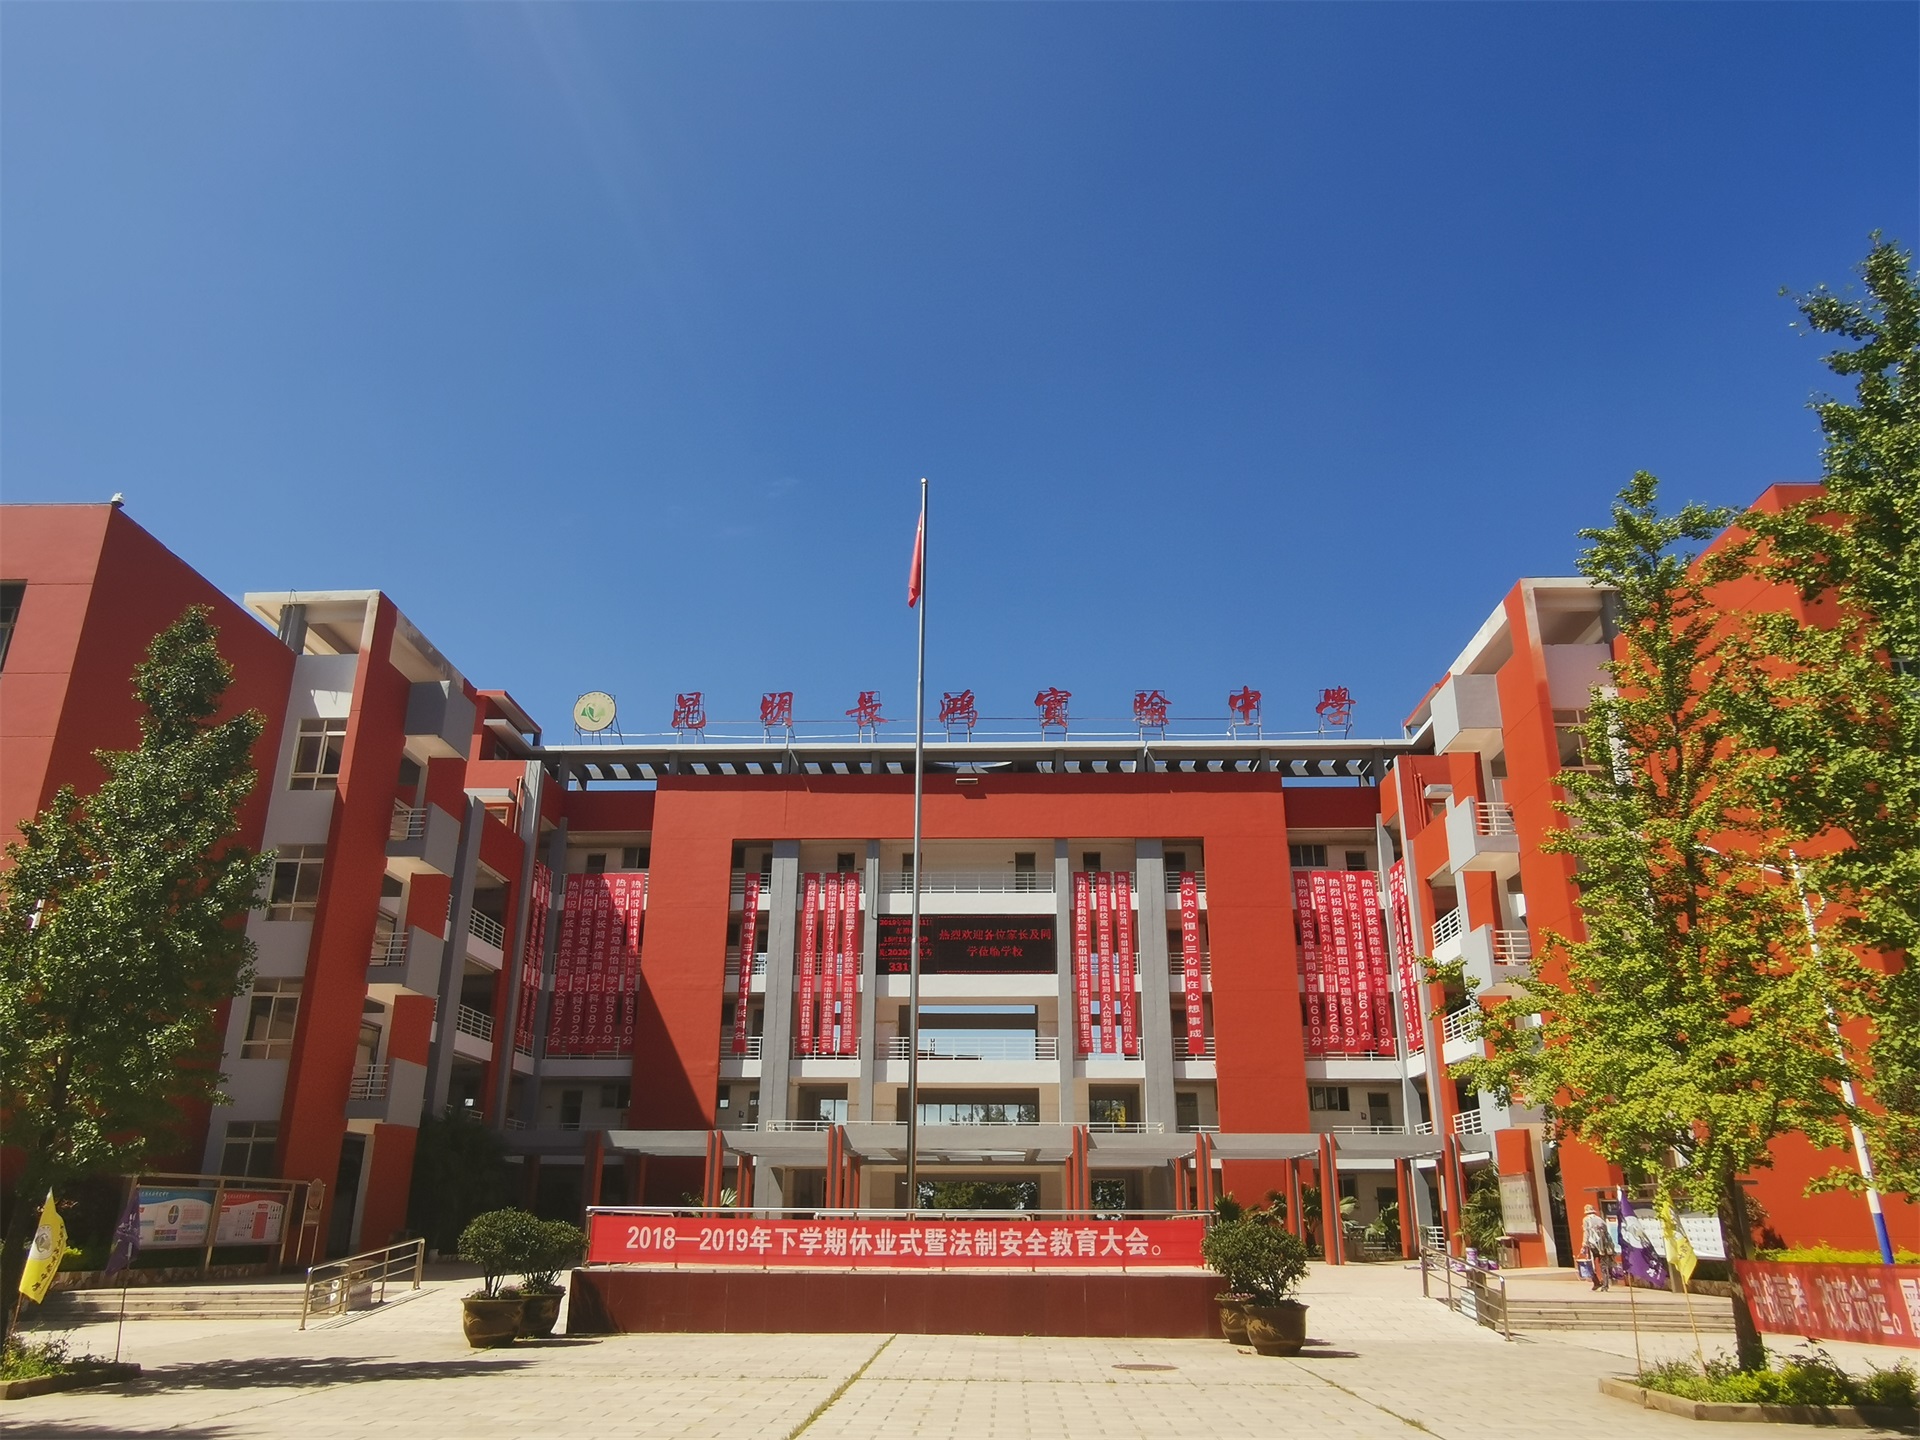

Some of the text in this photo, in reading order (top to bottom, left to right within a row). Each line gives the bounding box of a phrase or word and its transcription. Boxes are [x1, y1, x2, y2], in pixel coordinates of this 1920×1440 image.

[1181, 877, 1202, 1038] 信心决心恒心三心同在心想事成
[626, 1225, 1163, 1257] 2018—2019年下学期休业式暨法制安全教育大会。
